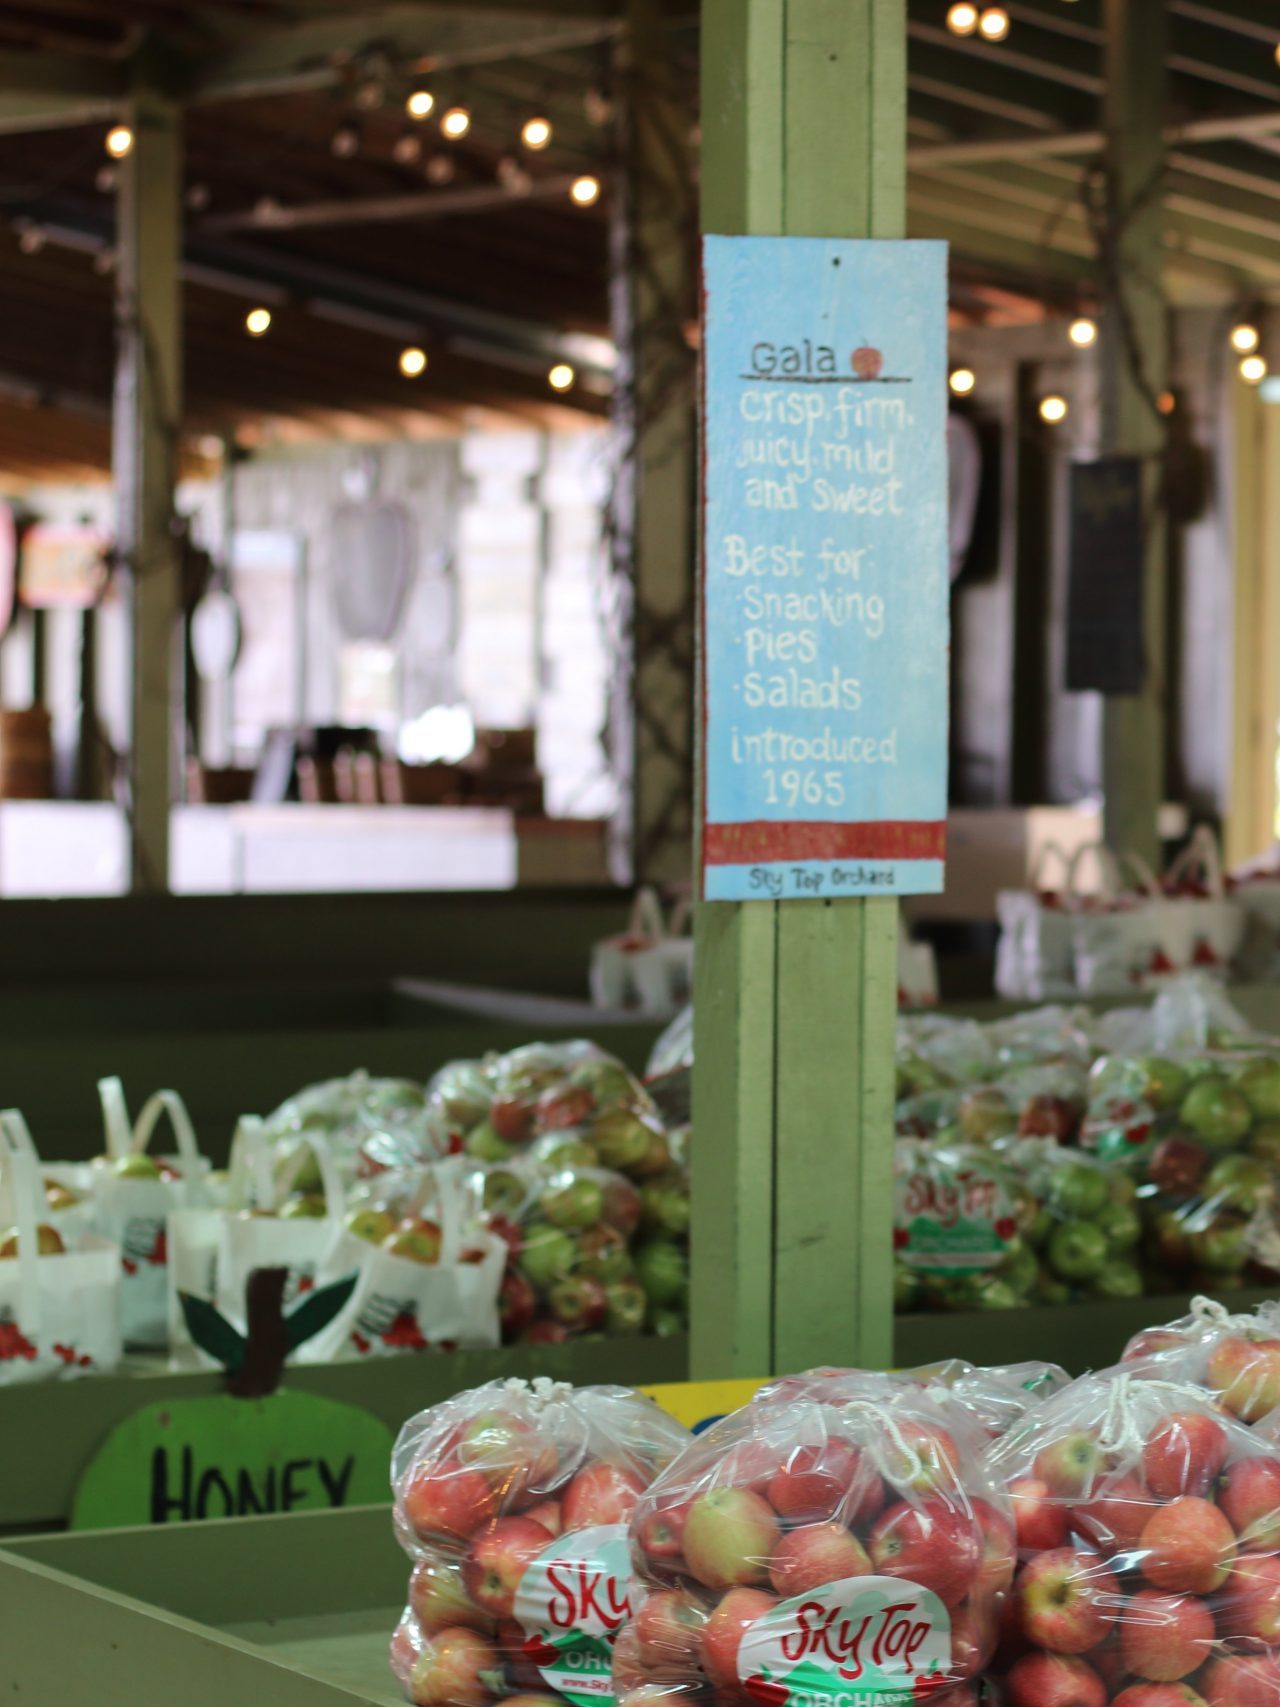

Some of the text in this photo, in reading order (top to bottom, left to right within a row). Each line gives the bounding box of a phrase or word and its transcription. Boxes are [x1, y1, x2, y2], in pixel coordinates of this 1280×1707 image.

[751, 339, 837, 374] Gala
[744, 477, 799, 511] and
[722, 534, 806, 577] Best
[743, 584, 886, 640] Snacking
[761, 768, 846, 807] 1965
[871, 1602, 932, 1674] Top
